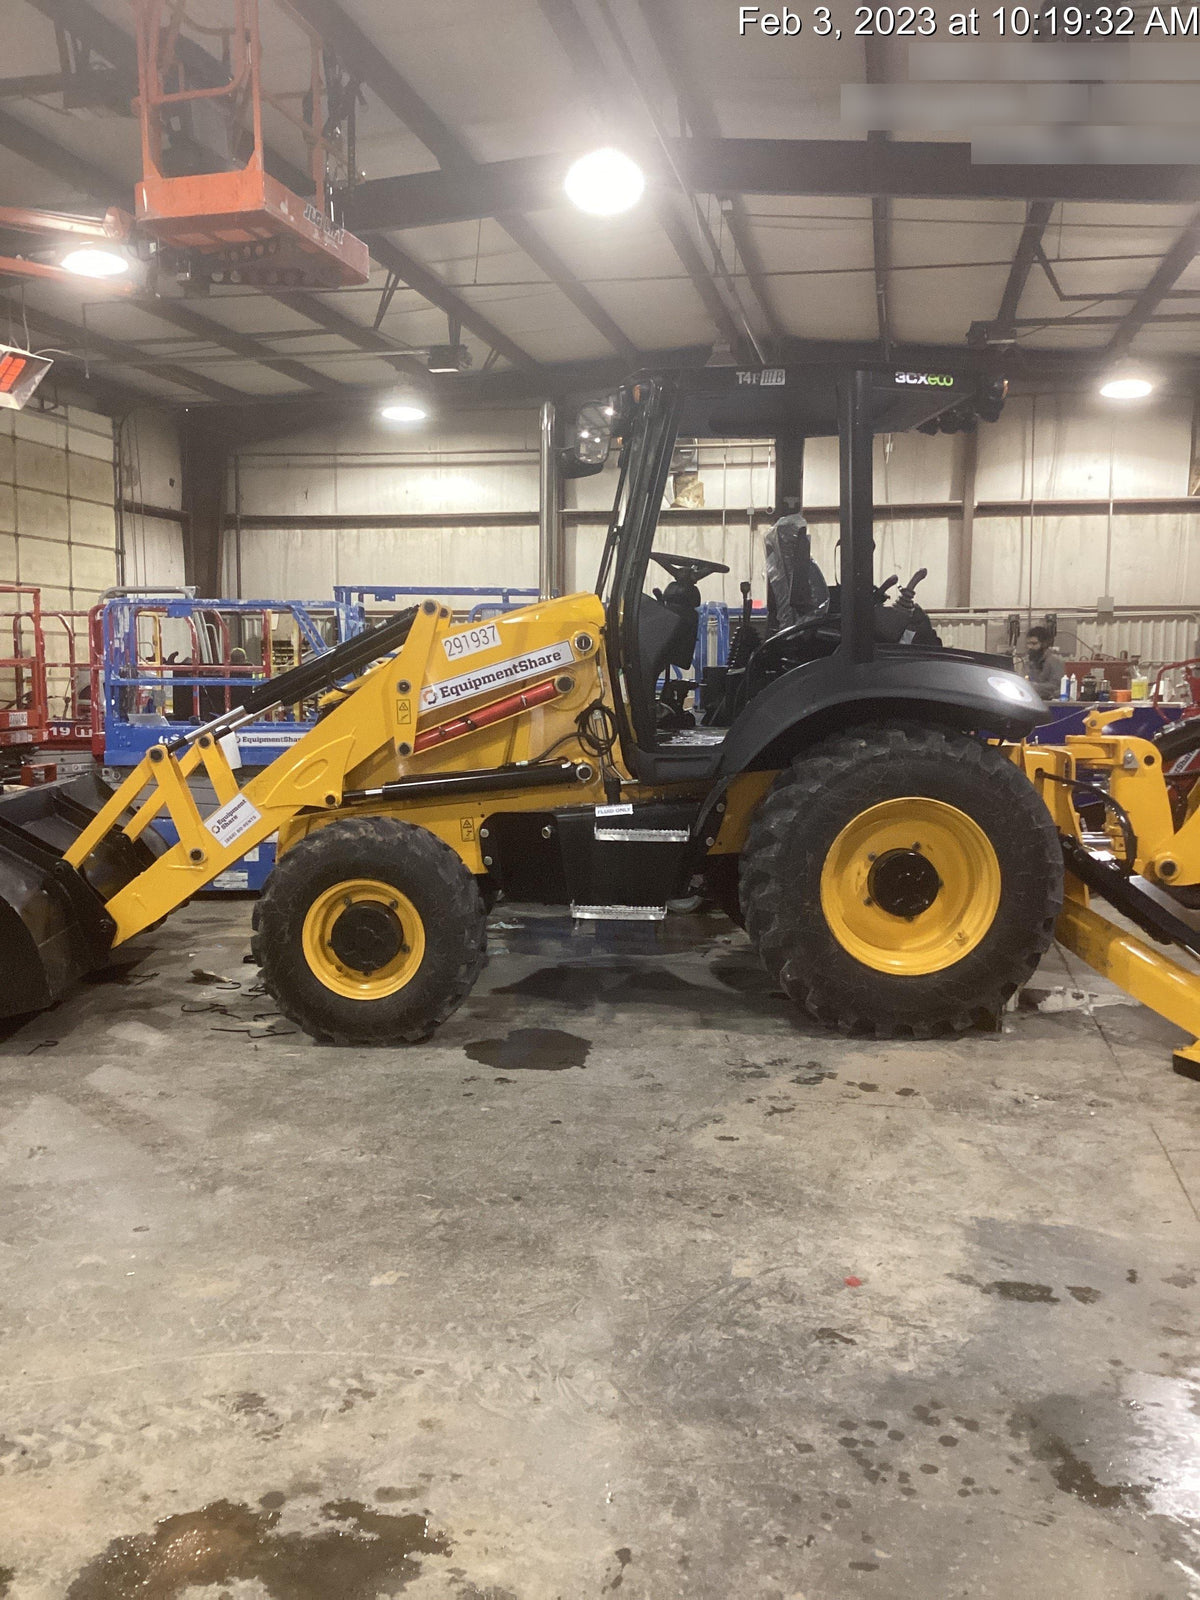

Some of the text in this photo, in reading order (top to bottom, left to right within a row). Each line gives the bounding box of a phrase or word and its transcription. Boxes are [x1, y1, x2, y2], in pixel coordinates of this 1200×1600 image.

[444, 625, 496, 657] 291937
[439, 651, 562, 699] EquipmentShare
[49, 726, 71, 736] 19
[217, 799, 247, 825] Equipment
